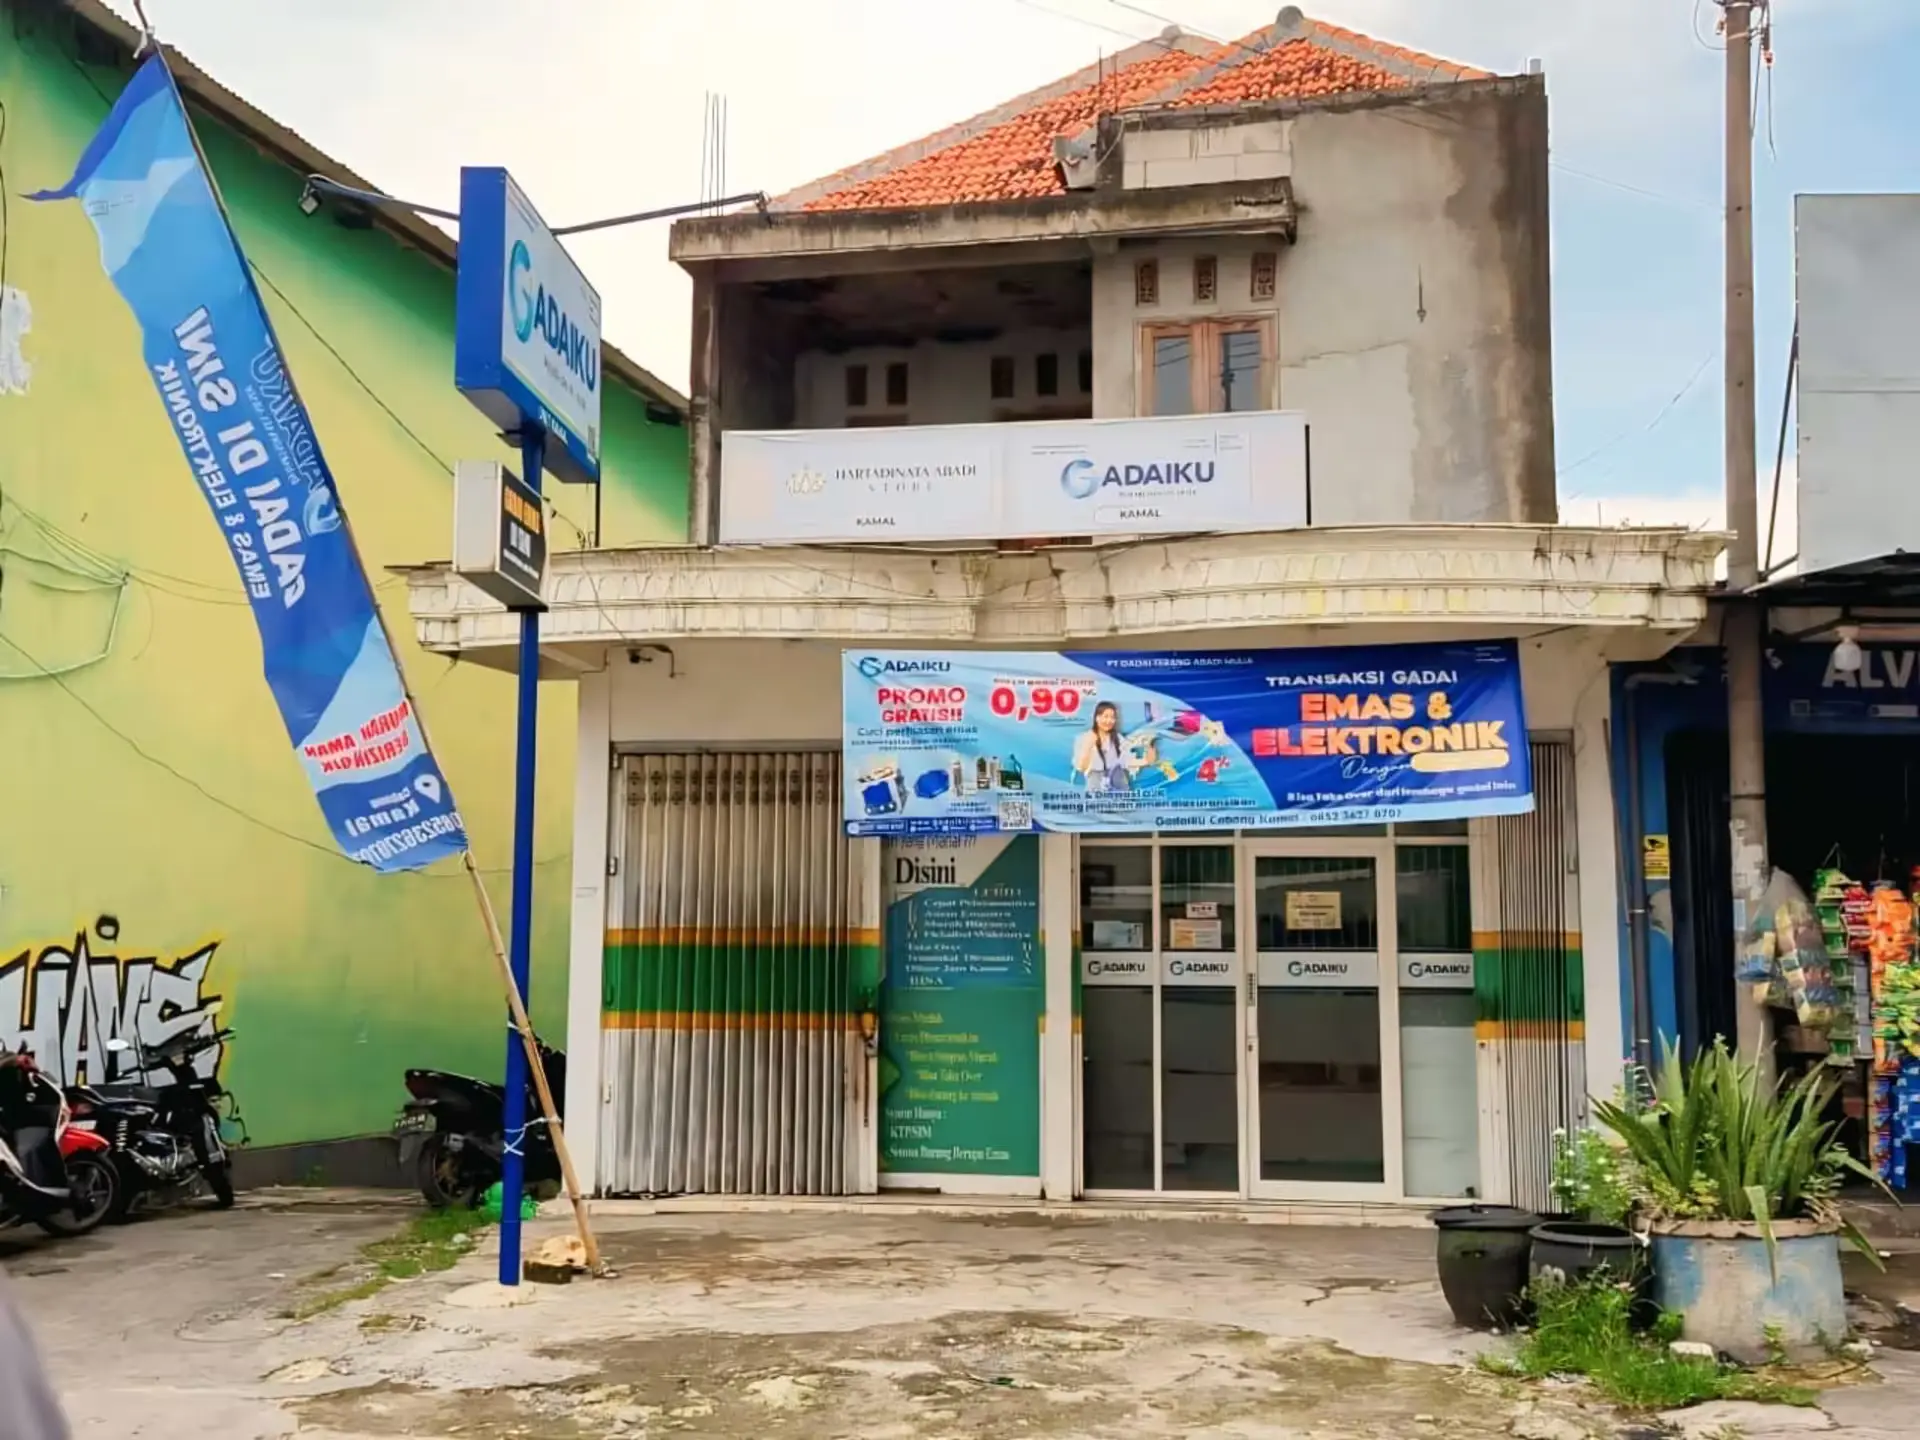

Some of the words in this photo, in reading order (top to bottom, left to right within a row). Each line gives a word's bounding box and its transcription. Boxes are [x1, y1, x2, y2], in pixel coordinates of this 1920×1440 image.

[508, 240, 596, 393] GADAIKU
[835, 466, 930, 480] HARTADINATA
[1061, 459, 1215, 499] GADAIKU
[856, 516, 896, 527] KAMAL
[1120, 508, 1161, 520] KAMAL
[860, 657, 951, 677] GADAIKU
[1821, 650, 1920, 688] ALV
[1266, 671, 1385, 687] TRANSAKSI
[1392, 670, 1458, 685] GADAI
[878, 687, 966, 705] PROMO
[1301, 692, 1414, 721] EMAS
[1428, 691, 1452, 720] &
[882, 708, 962, 723] GRATIS!!
[1252, 720, 1509, 756] ELEKTRONIK
[895, 856, 956, 884] Disini
[1088, 961, 1146, 975] GADAIKU
[1170, 961, 1229, 975] GADAIKU
[1288, 961, 1348, 976] GADAIKU
[1408, 962, 1470, 977] GADAIKU
